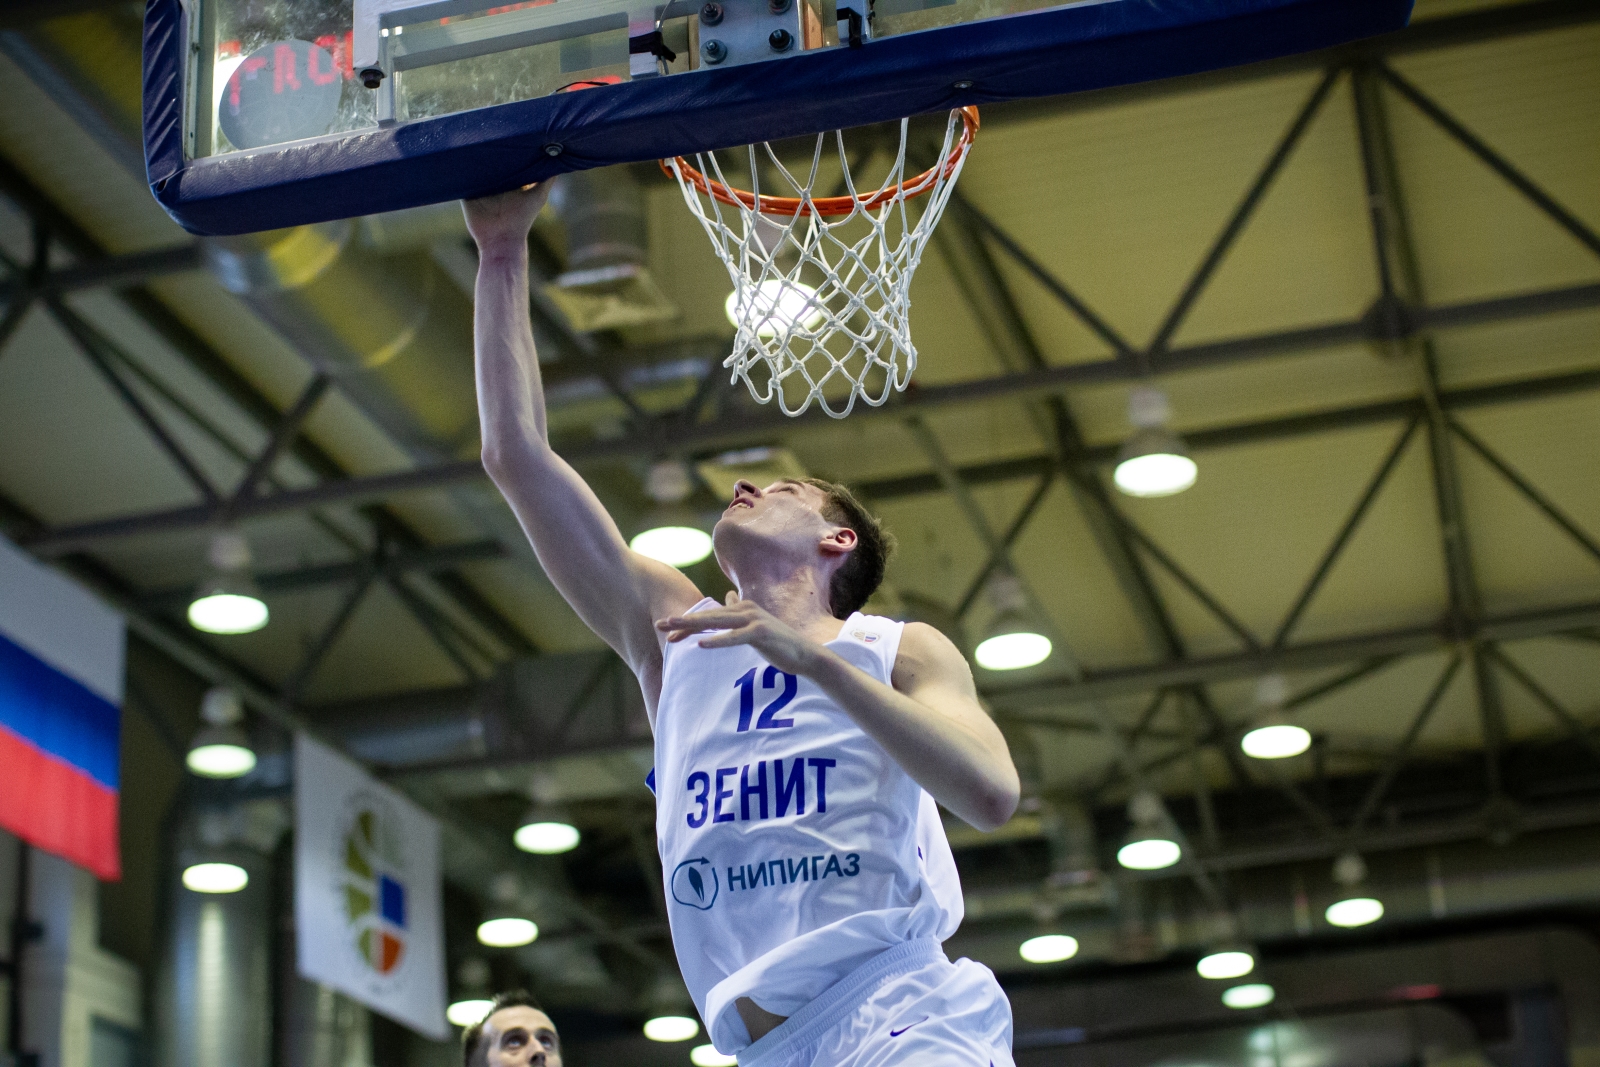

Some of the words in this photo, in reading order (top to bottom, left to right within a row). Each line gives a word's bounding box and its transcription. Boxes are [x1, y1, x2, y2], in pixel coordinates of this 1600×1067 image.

[733, 665, 798, 732] 12
[686, 757, 836, 829] ЗЕНИТ
[727, 853, 861, 892] НИПИГАЗ
